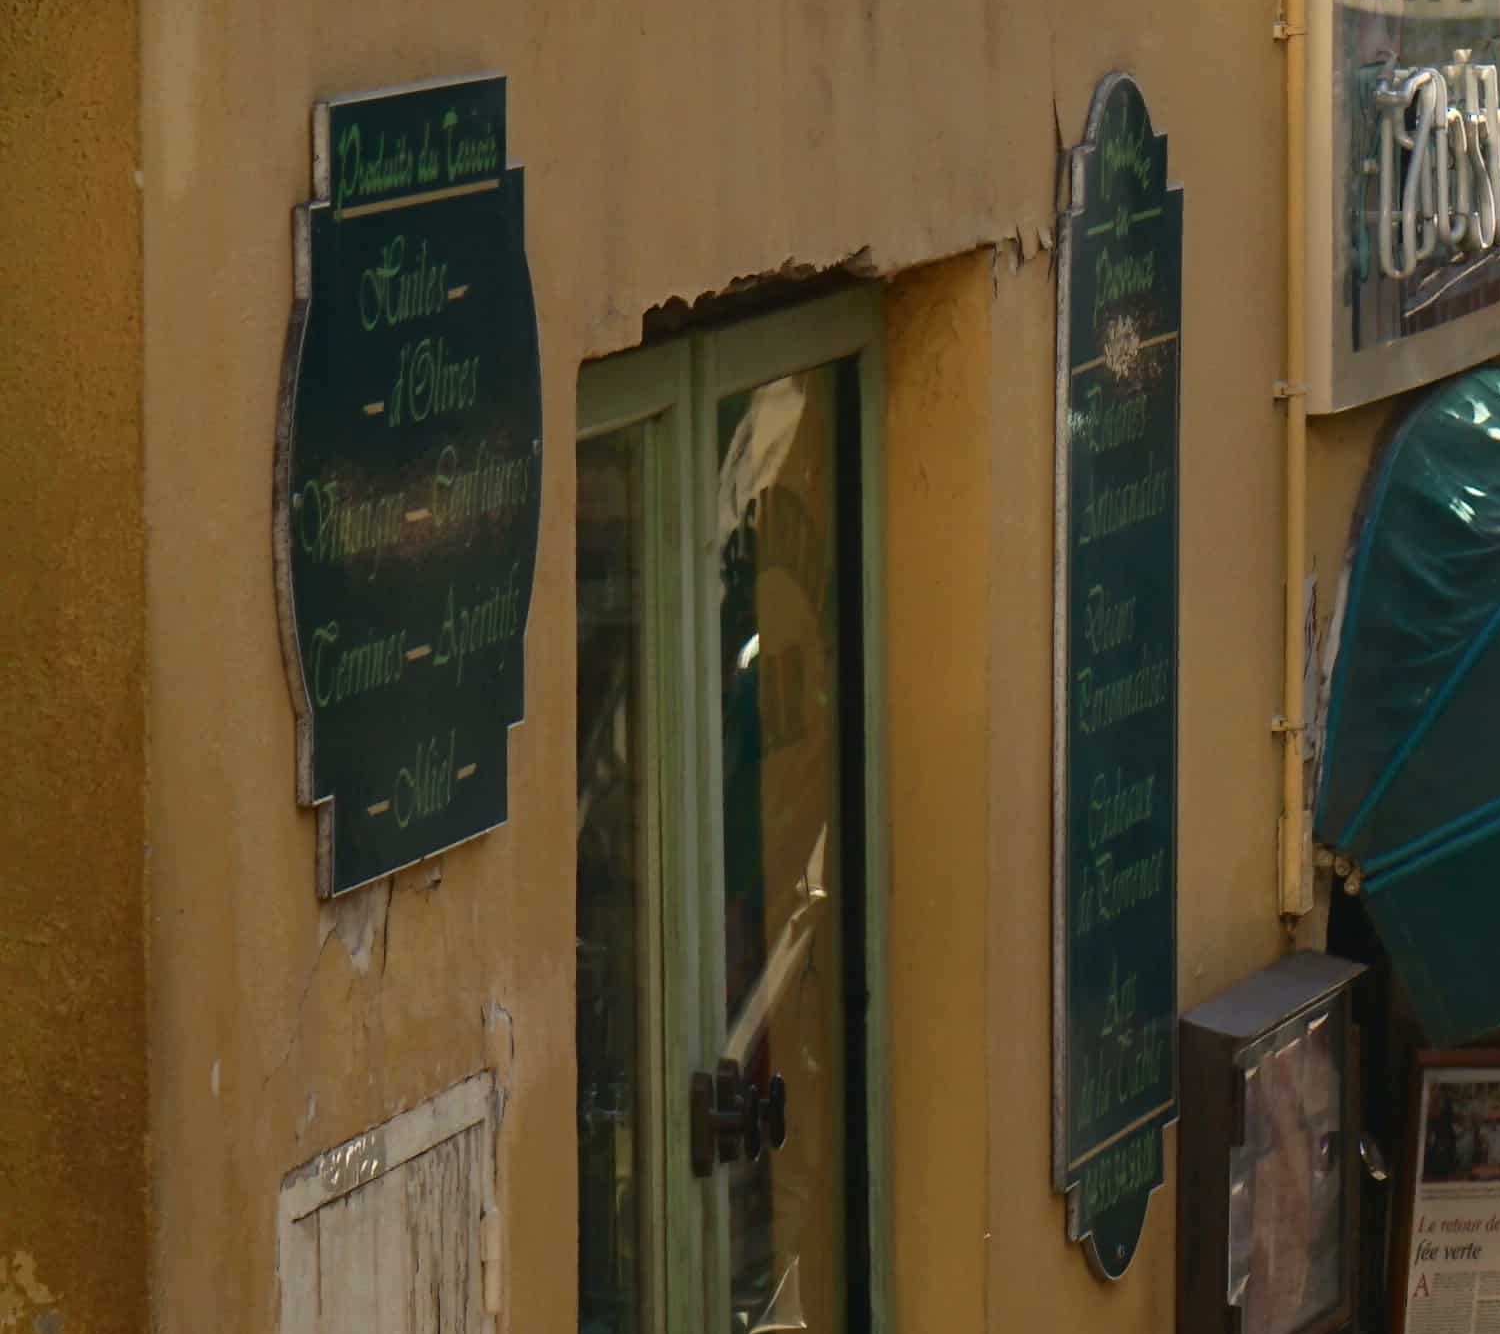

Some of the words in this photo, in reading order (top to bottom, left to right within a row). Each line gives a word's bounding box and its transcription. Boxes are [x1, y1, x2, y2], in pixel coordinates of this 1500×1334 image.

[337, 121, 413, 227] Produits
[418, 120, 440, 184] du
[441, 106, 498, 181] Terroir
[359, 234, 449, 331] Huiles
[388, 336, 480, 429] d'Olives
[431, 440, 529, 548] Confitures
[311, 620, 407, 707] Terrines
[393, 725, 456, 828] Miel
[1414, 1240, 1438, 1264] fée
[1444, 1241, 1483, 1261] verte
[1418, 1215, 1437, 1233] Le
[1440, 1217, 1482, 1234] retour
